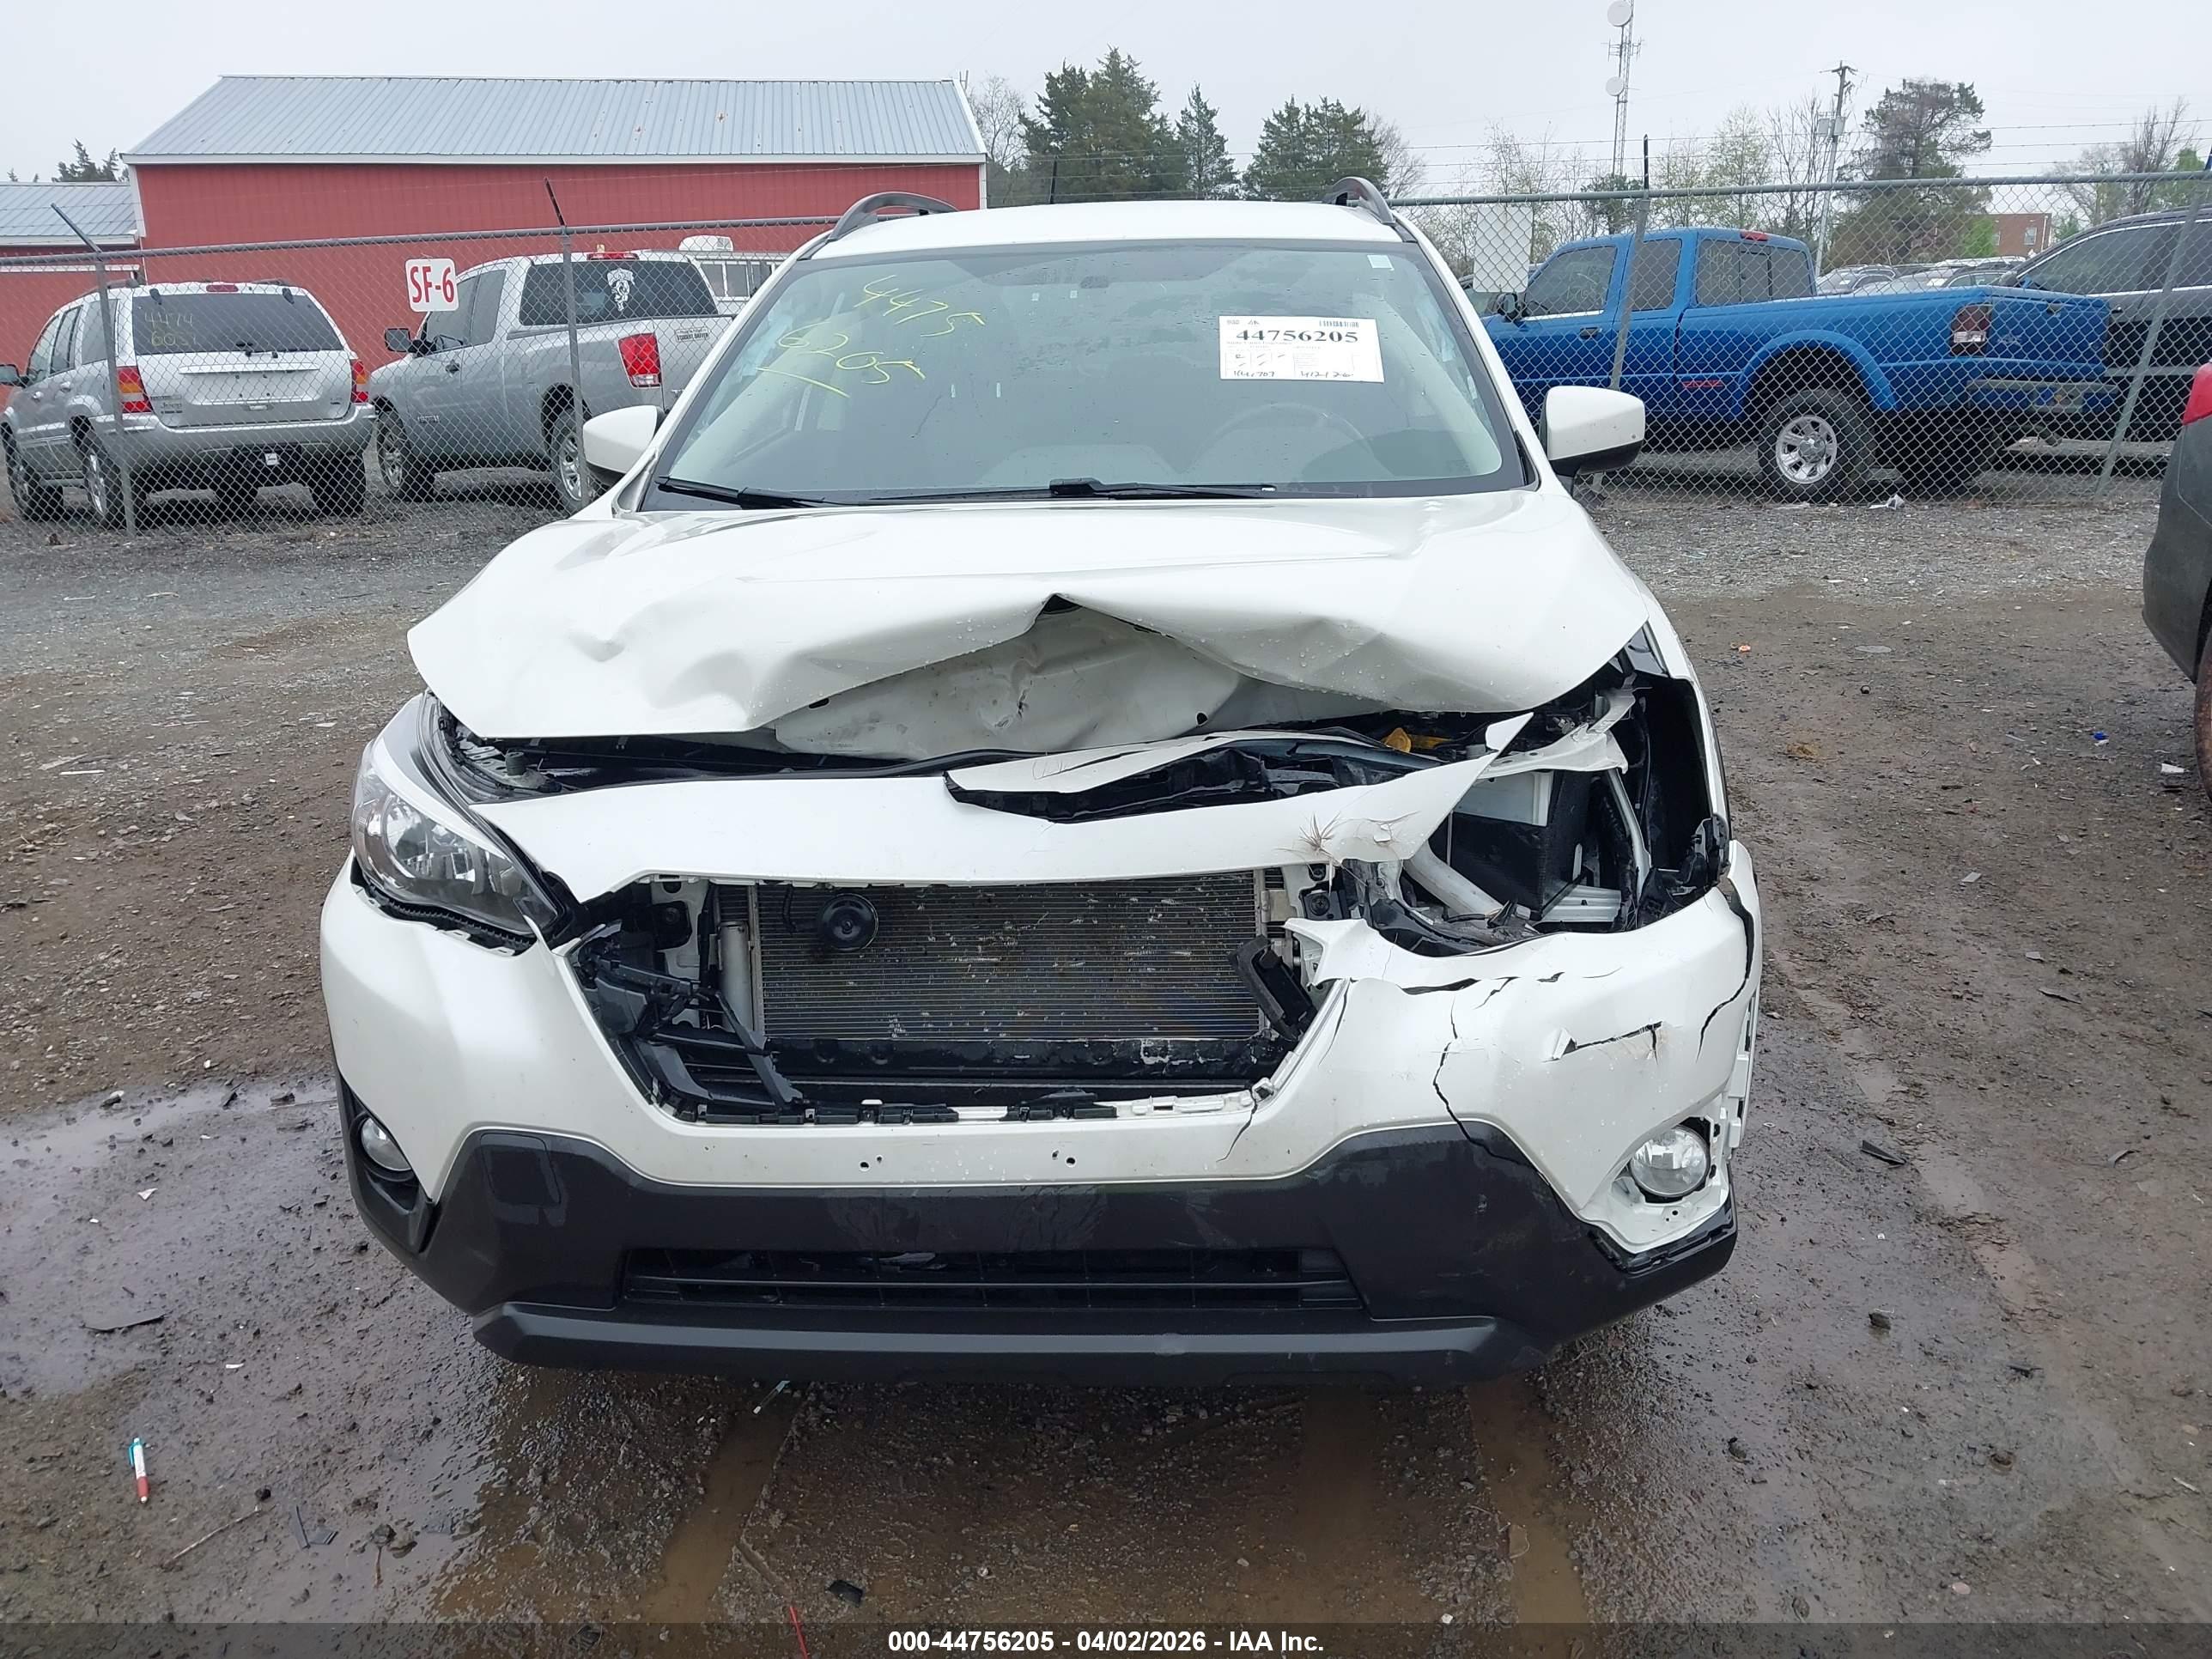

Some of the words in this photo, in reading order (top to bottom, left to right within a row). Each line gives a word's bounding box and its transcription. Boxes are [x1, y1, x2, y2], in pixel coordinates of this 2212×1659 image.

[410, 265, 454, 303] SF-6
[854, 274, 985, 337] 4475
[778, 321, 926, 385] 6205
[1236, 329, 1358, 343] 44756205
